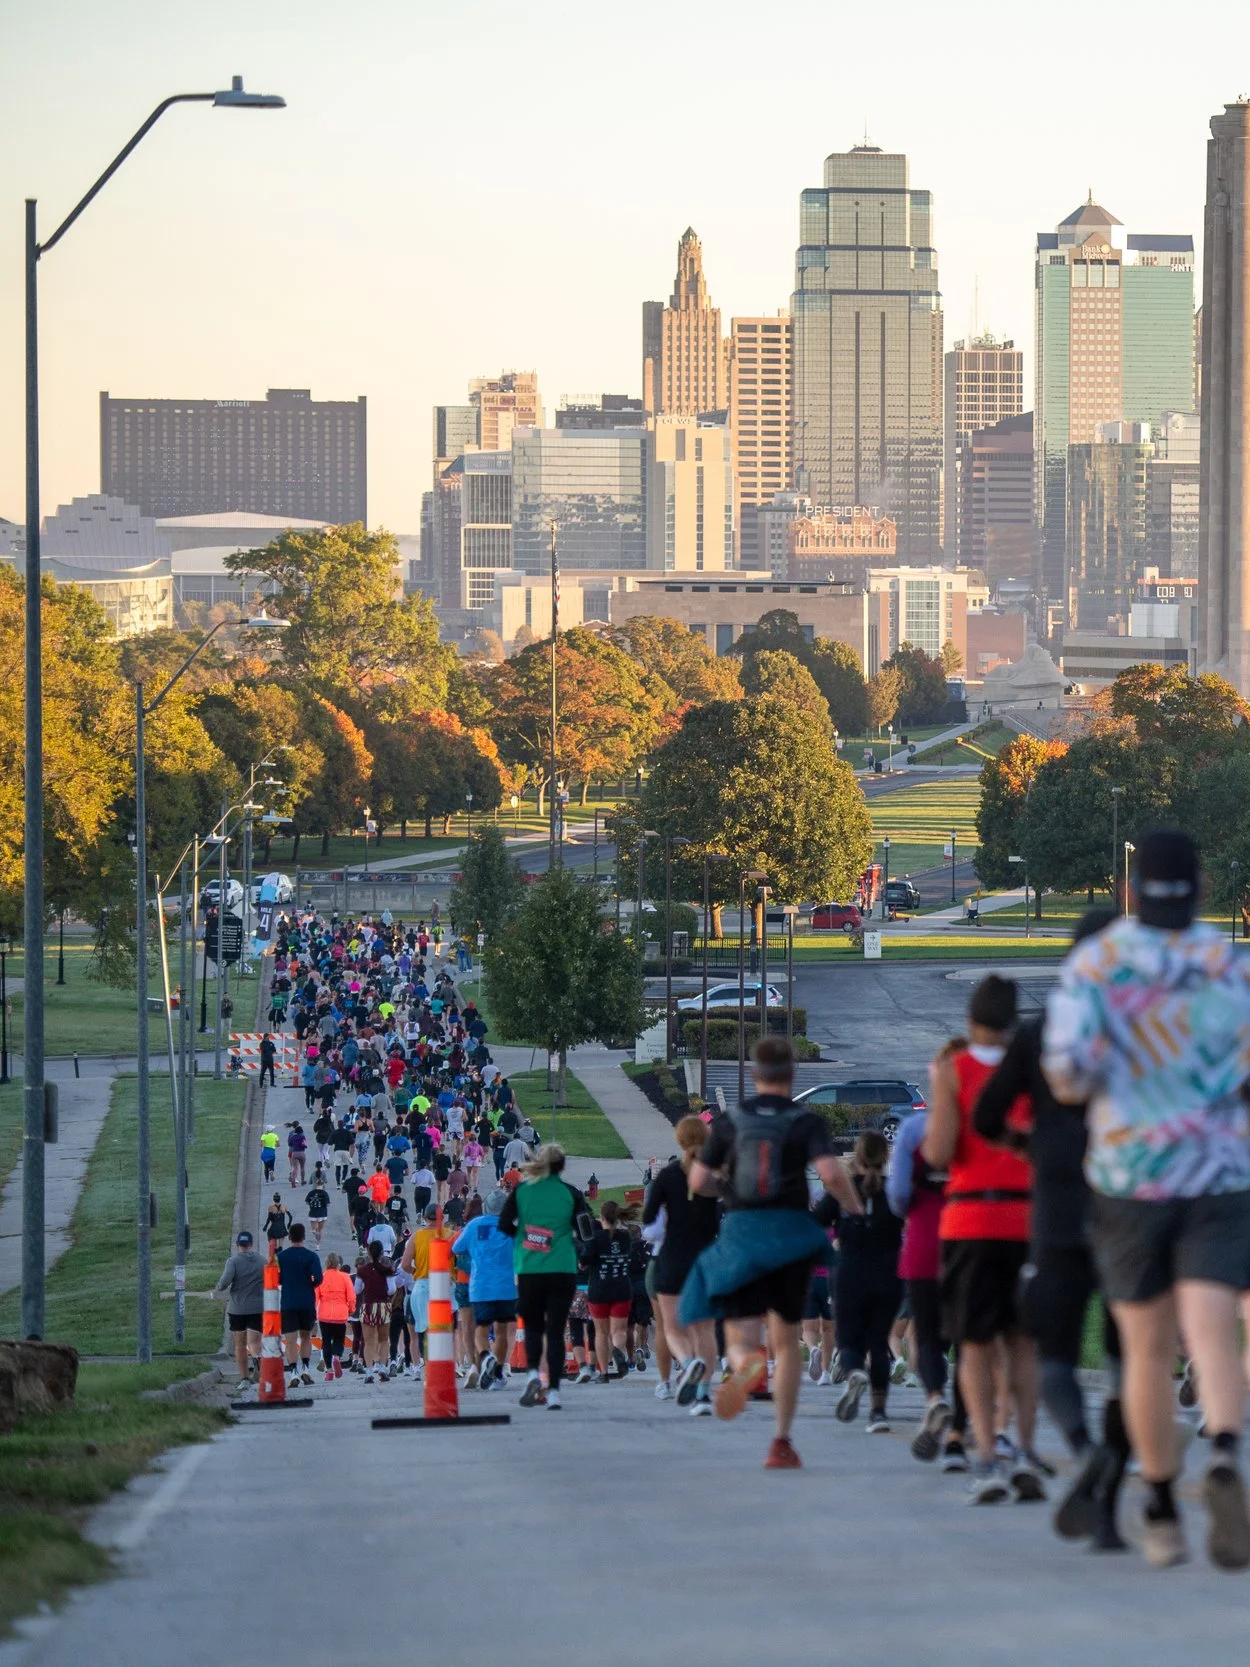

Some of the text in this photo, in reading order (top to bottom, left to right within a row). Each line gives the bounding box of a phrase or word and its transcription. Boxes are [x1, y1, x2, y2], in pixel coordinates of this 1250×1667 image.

[214, 400, 250, 408] Marriott
[805, 505, 880, 517] PRESIDENT
[260, 913, 270, 932] 4
